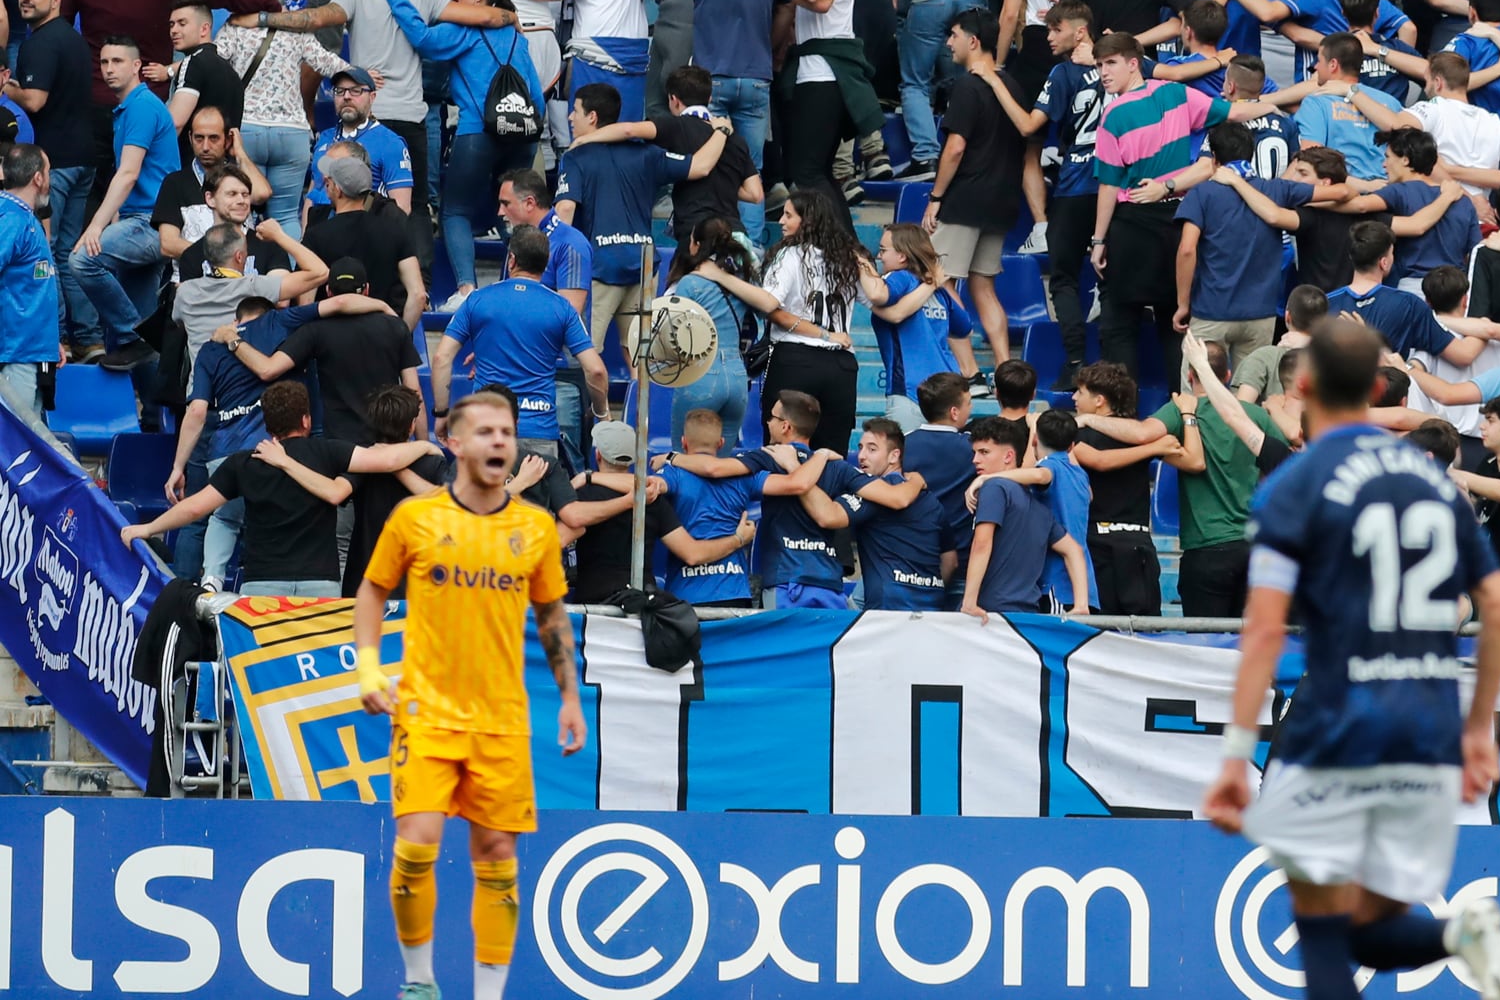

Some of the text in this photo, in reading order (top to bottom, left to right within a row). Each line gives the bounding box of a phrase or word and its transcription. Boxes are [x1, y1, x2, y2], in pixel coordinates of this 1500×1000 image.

[494, 103, 533, 117] adidas
[520, 397, 551, 412] Auto
[782, 536, 826, 551] Tartiere
[682, 562, 726, 578] Tartiere
[1352, 500, 1458, 632] 12
[453, 564, 524, 593] tvitec
[893, 569, 931, 587] Tartiere
[534, 824, 1150, 1000] exiom
